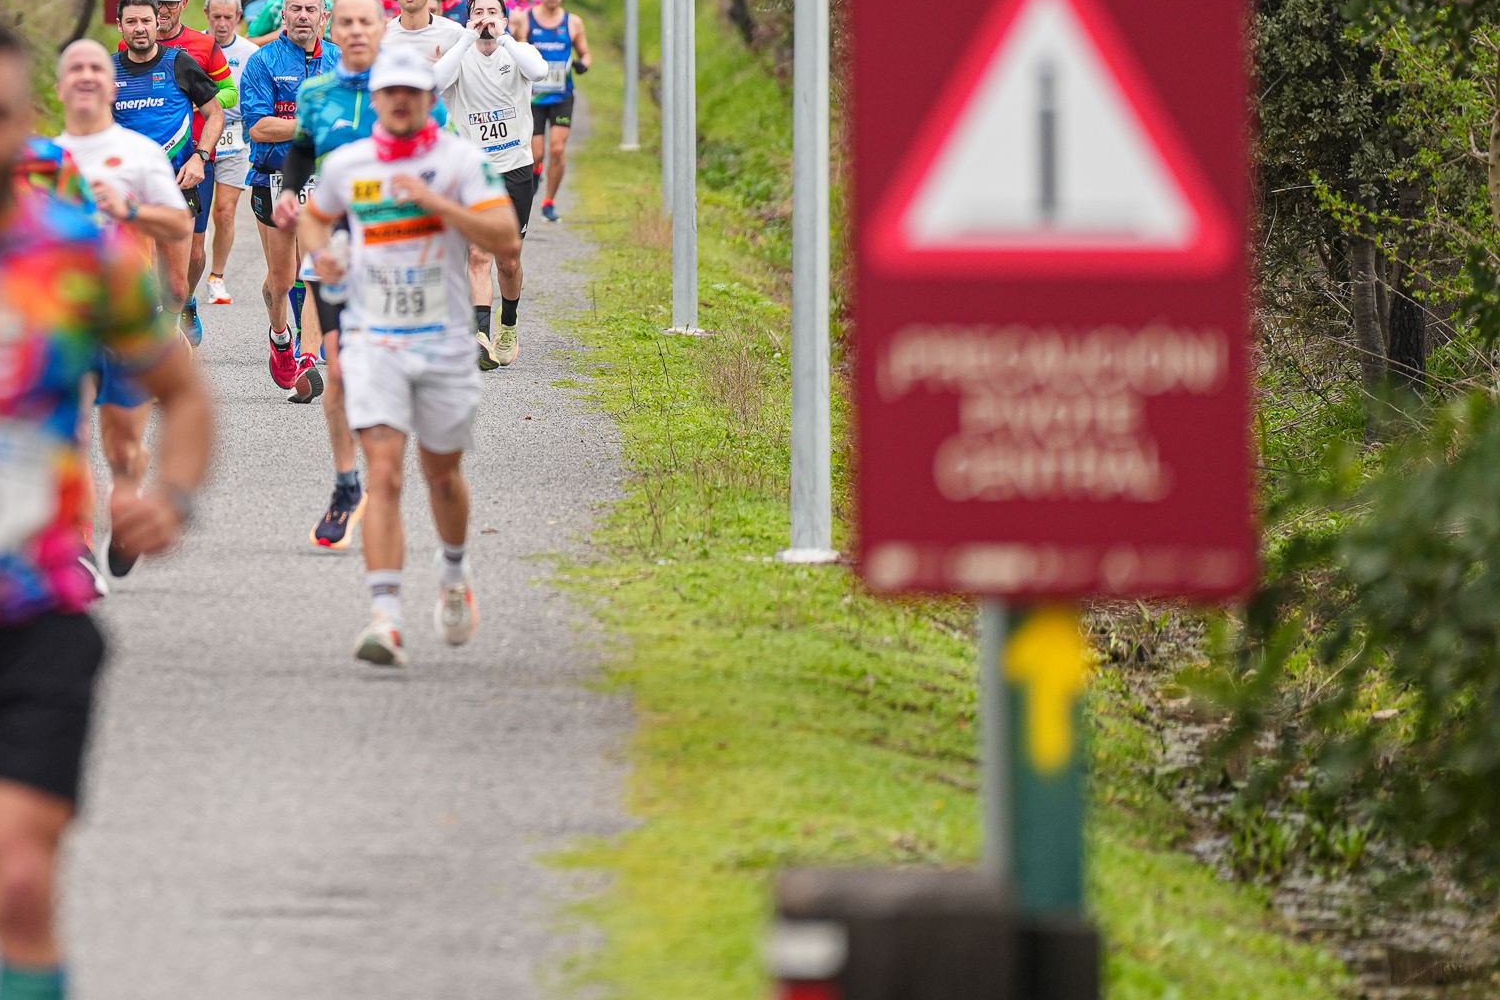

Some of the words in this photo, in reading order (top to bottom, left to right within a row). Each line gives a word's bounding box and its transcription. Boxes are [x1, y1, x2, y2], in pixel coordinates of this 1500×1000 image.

[115, 97, 165, 111] enerplus
[480, 122, 508, 141] 240
[381, 288, 425, 317] 789
